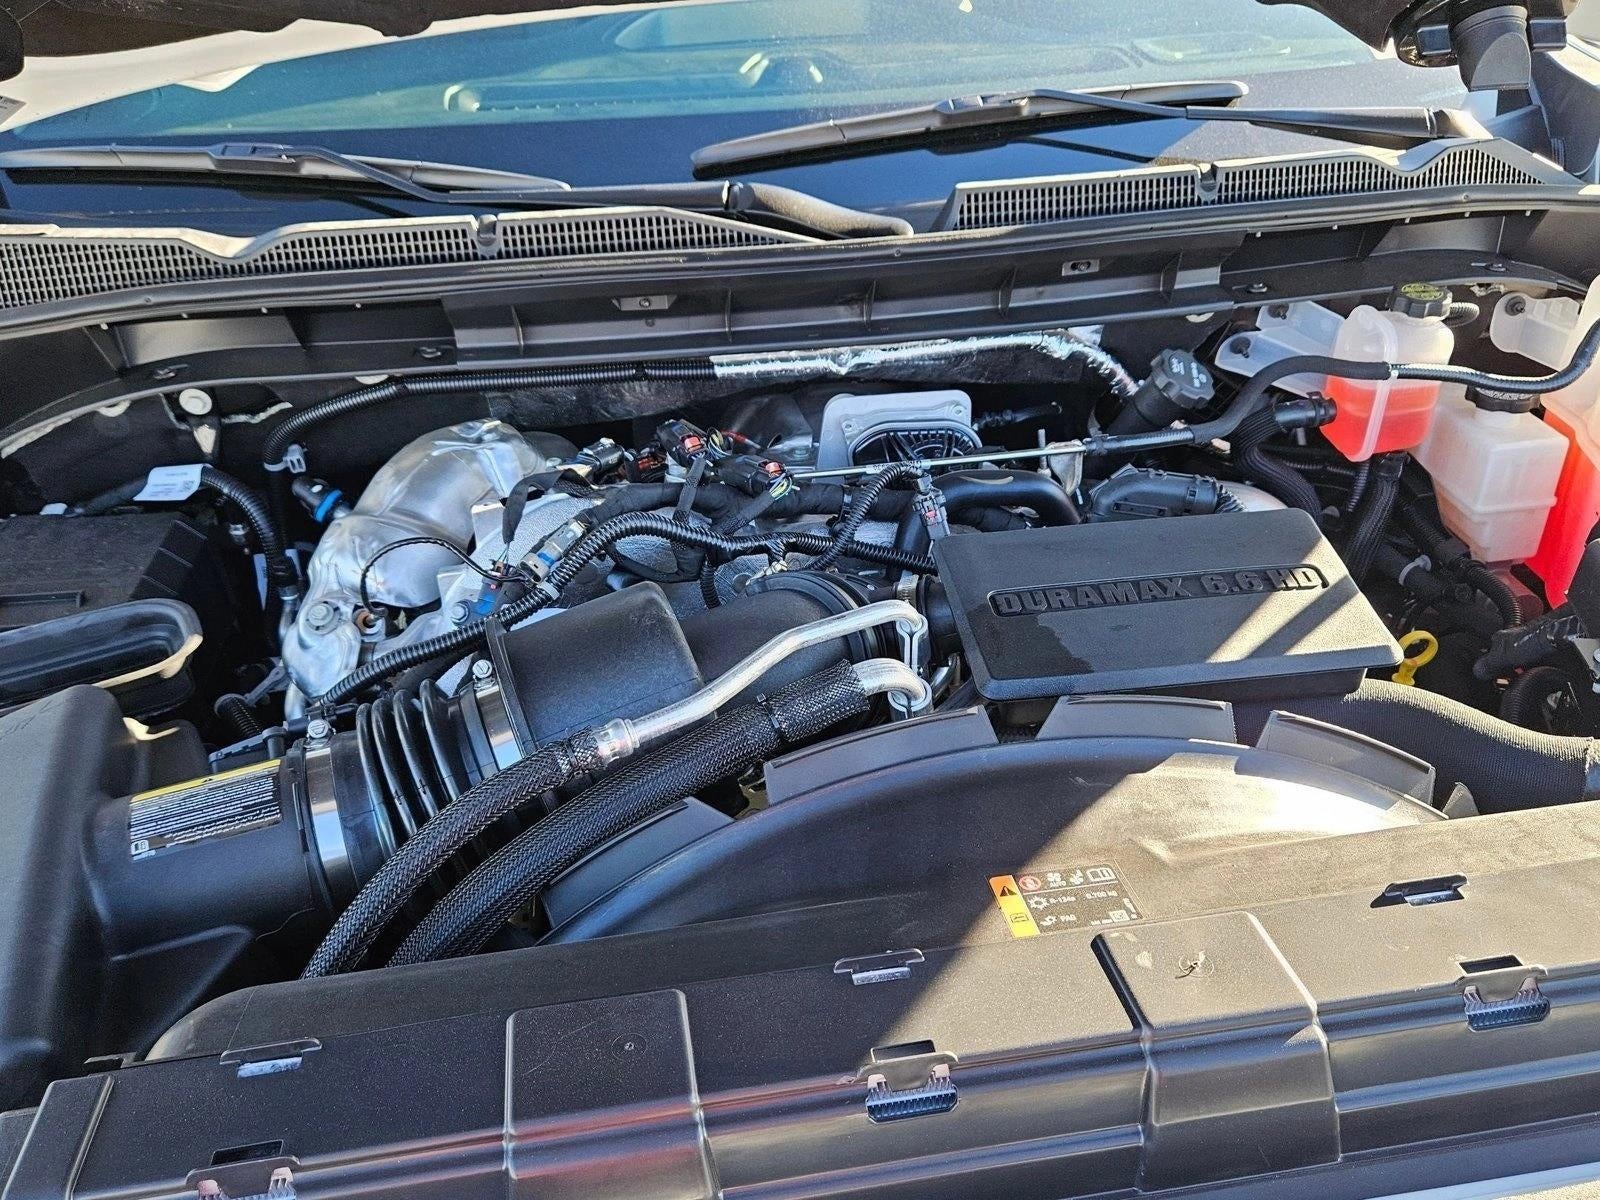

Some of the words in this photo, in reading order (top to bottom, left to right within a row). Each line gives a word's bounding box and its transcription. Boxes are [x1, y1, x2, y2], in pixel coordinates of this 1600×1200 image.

[998, 577, 1191, 614] DURAMAX
[1201, 568, 1264, 594] 6.6
[1272, 567, 1325, 591] HD
